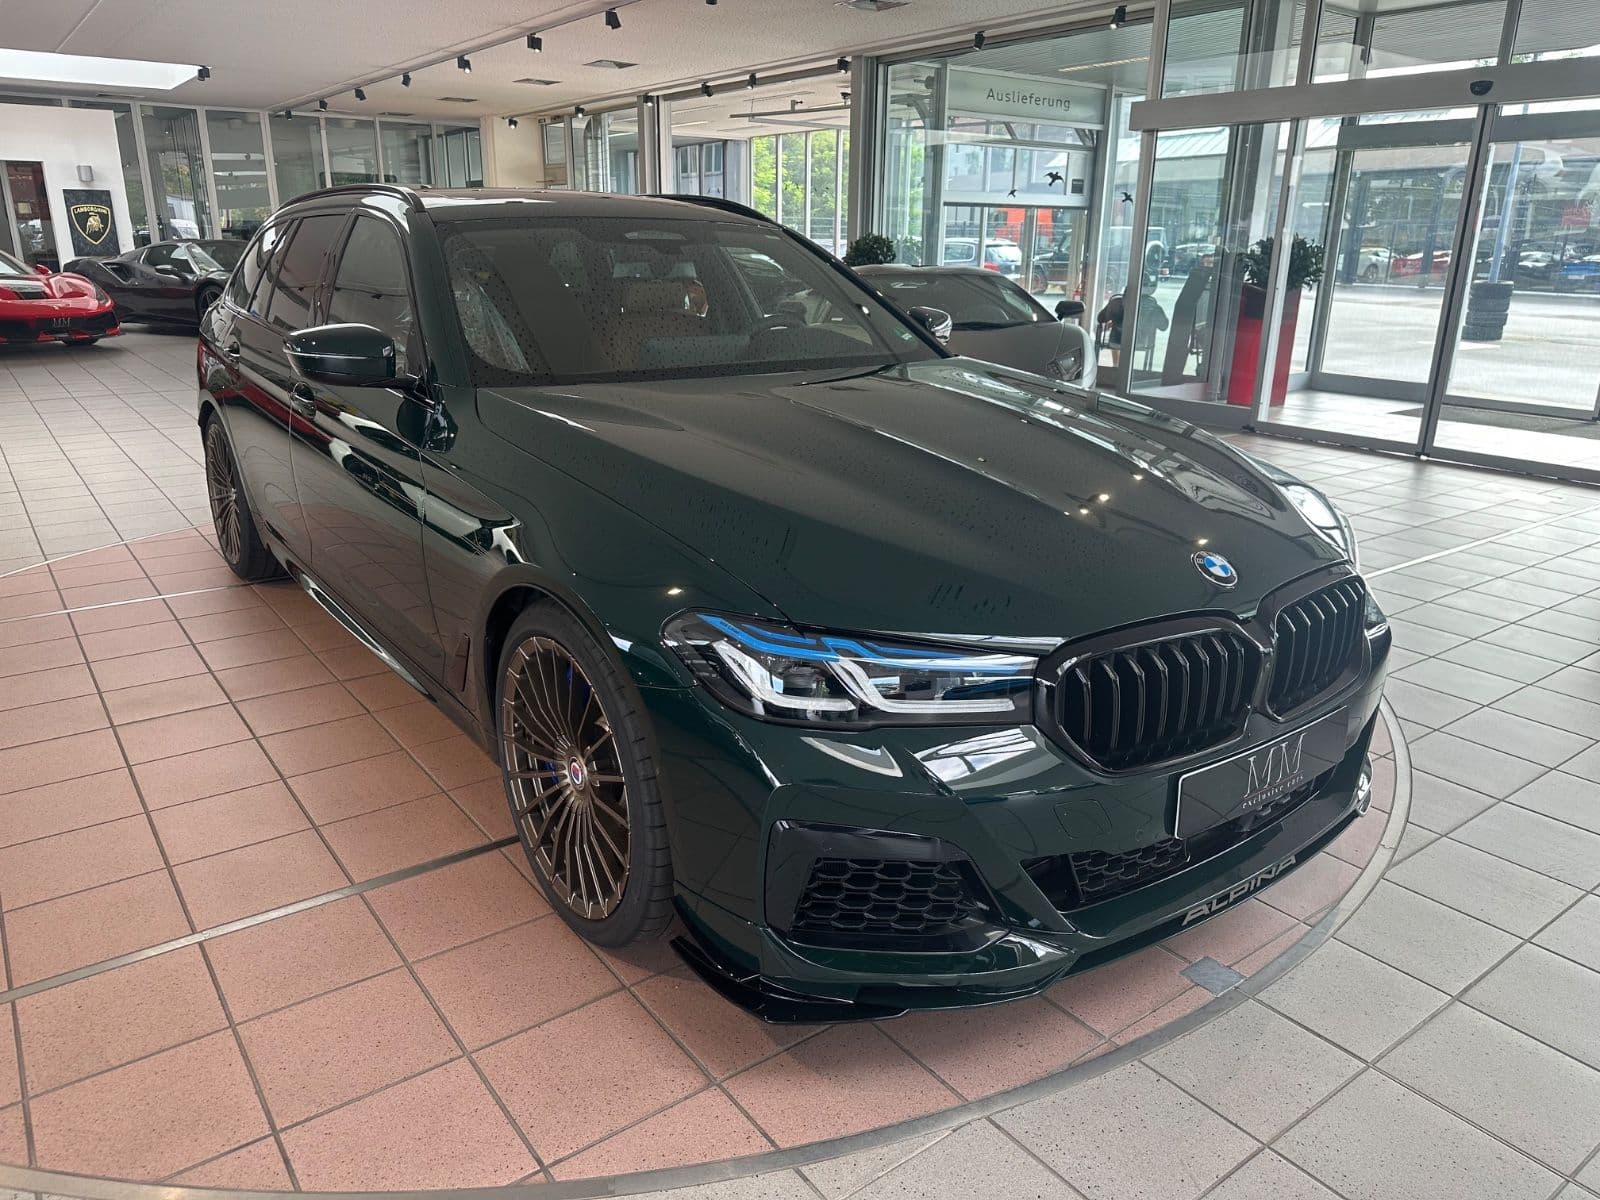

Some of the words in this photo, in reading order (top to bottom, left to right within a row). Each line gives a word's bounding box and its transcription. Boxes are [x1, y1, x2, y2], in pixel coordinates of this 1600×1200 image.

[986, 87, 1071, 112] Auslieferung
[1242, 732, 1307, 798] MM
[1242, 786, 1284, 809] exclusive
[1286, 775, 1304, 788] cars
[1181, 855, 1297, 926] ALPINA
